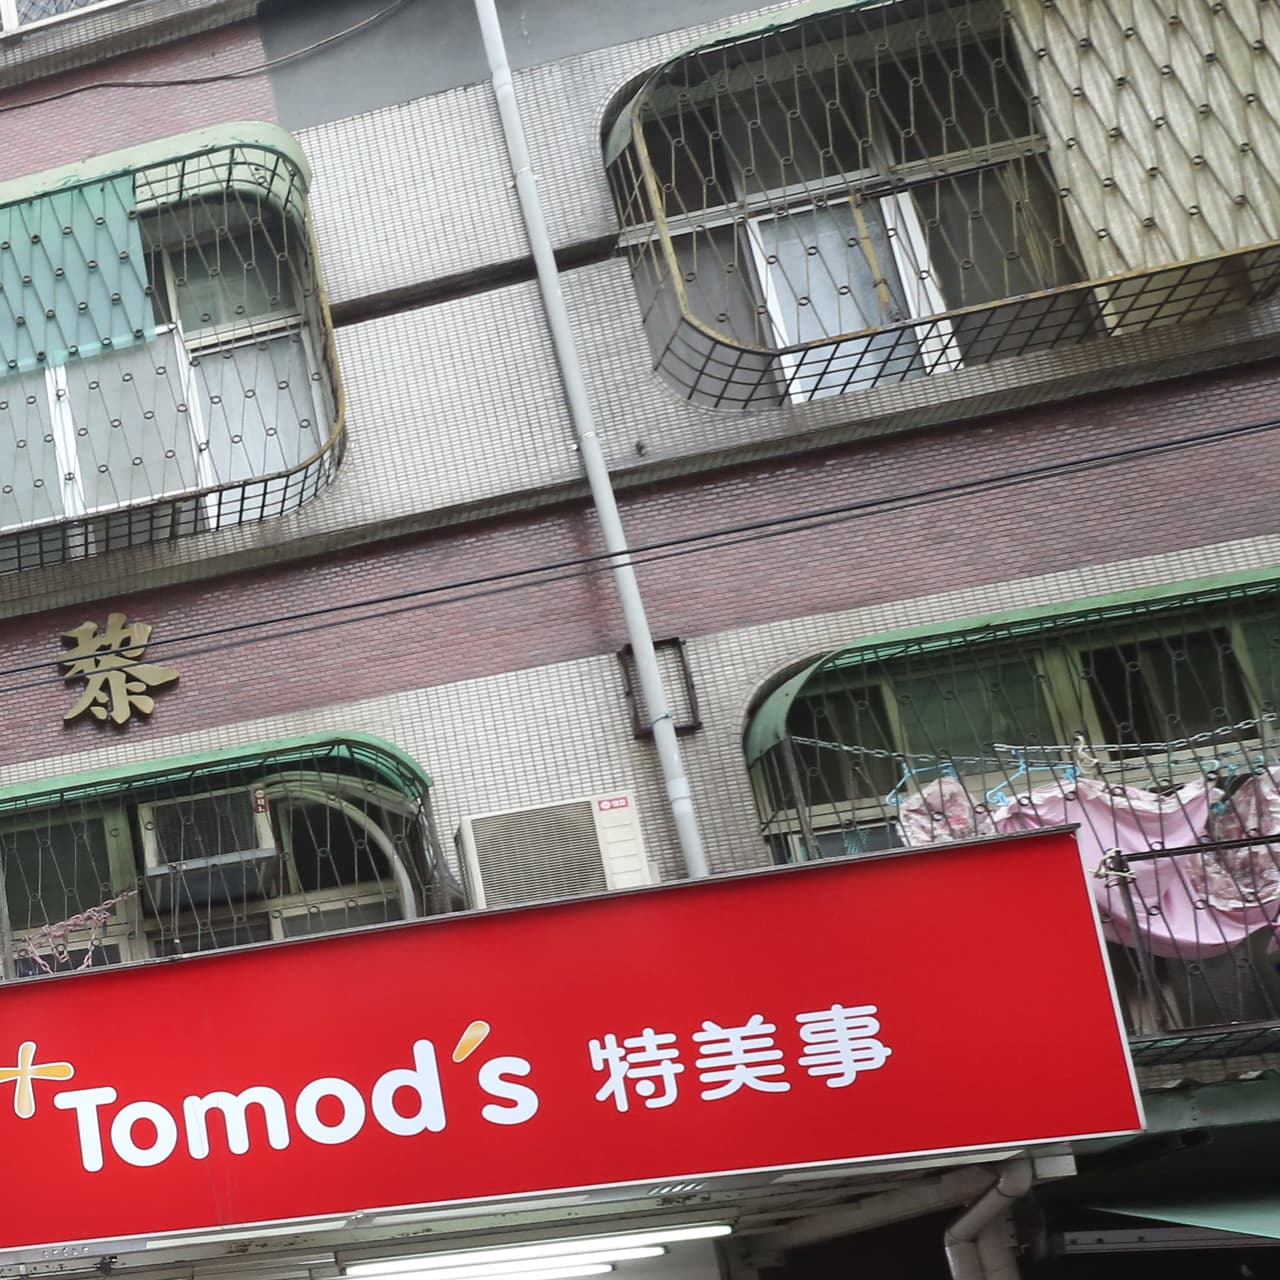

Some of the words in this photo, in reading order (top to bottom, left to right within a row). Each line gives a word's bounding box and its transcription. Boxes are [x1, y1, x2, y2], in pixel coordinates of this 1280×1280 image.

[55, 1020, 539, 1172] Tomod's
[589, 1004, 893, 1112] 特美事
